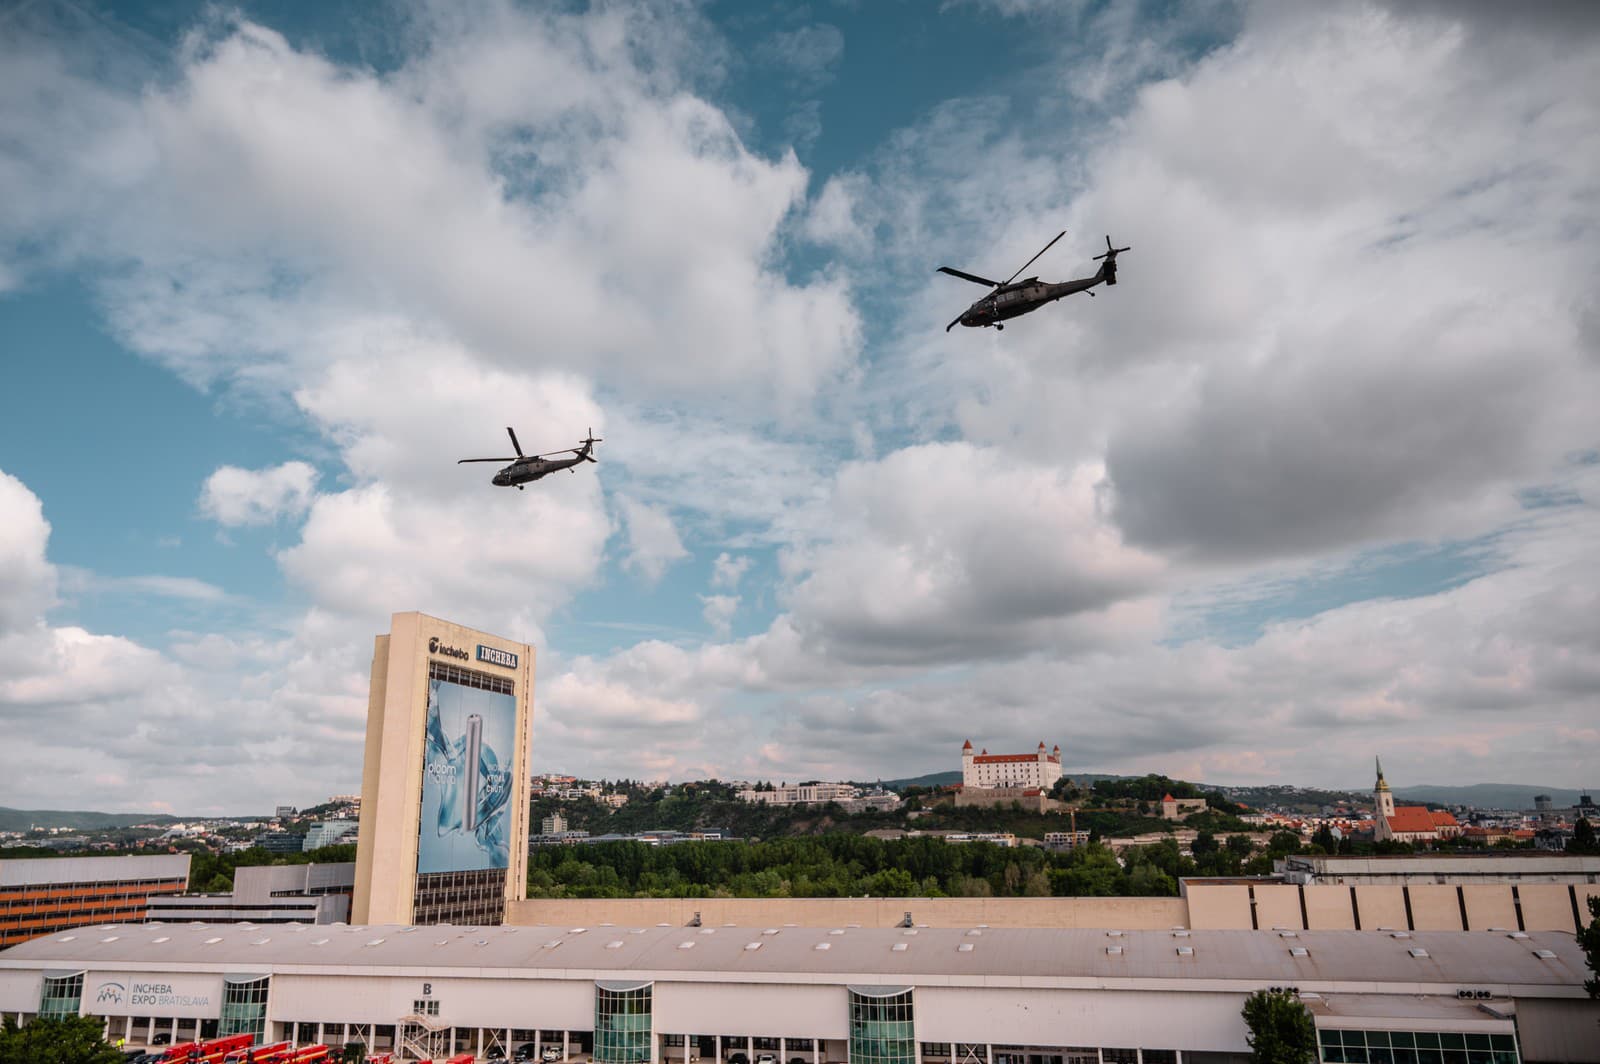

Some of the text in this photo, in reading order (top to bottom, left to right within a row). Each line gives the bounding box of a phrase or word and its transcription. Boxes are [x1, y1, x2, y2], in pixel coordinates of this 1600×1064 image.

[480, 646, 516, 667] INCHEBA
[428, 760, 456, 776] ploom
[132, 983, 172, 994] INCHEBA
[423, 983, 432, 995] B
[131, 995, 209, 1006] EXPO BRATISLAVA
